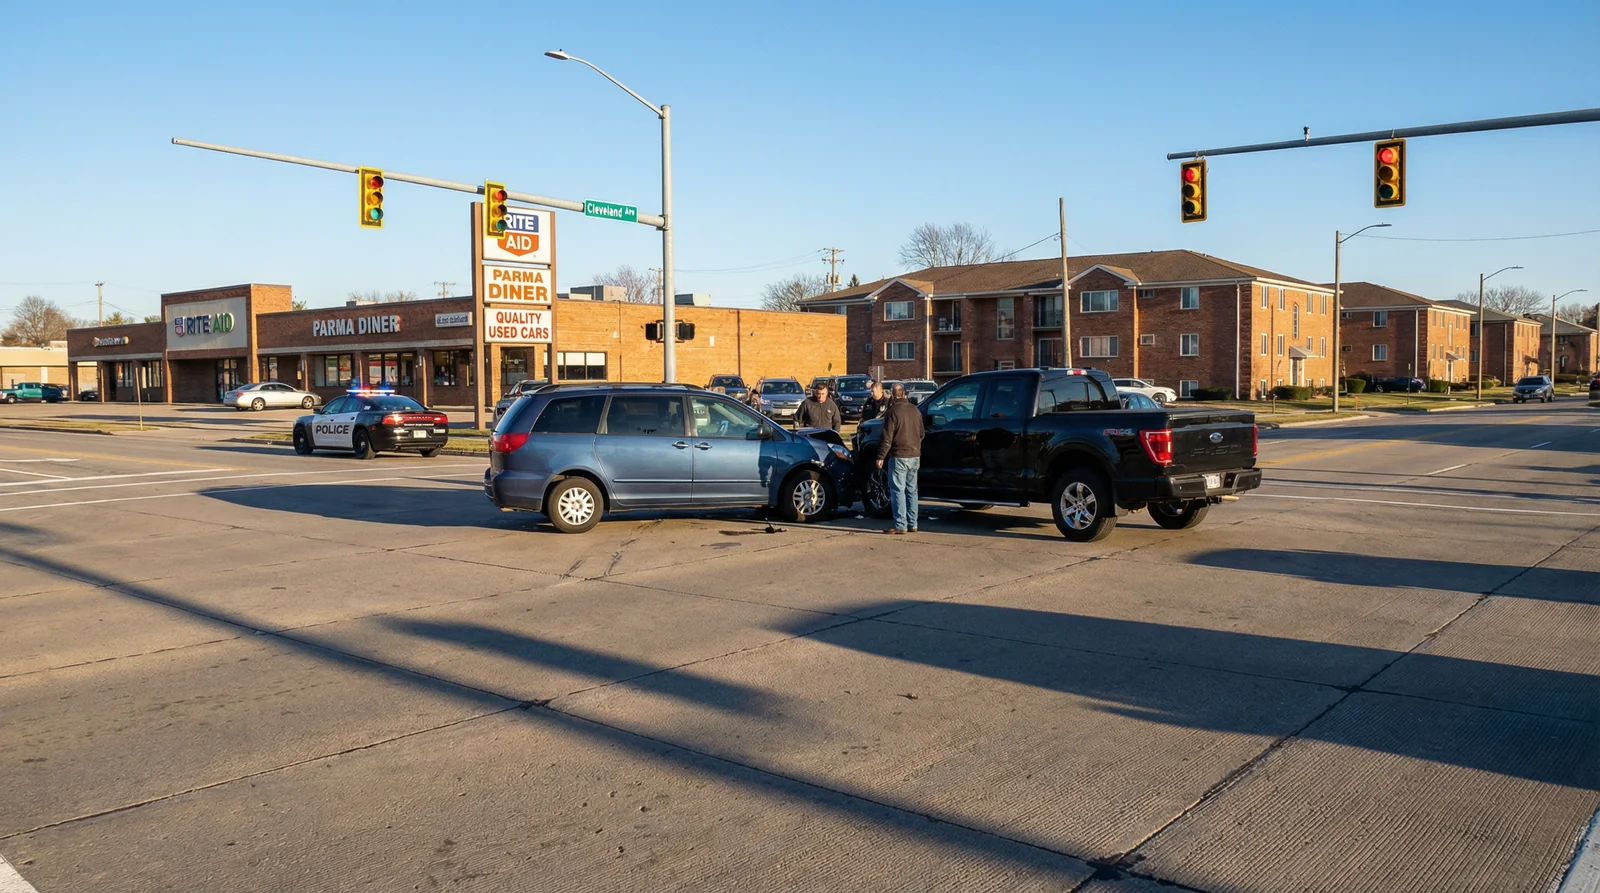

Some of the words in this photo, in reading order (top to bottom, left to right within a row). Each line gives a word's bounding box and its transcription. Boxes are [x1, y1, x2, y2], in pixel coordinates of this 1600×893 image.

[587, 203, 623, 218] Cleveland
[504, 213, 535, 231] RITE
[505, 234, 532, 251] AID
[493, 269, 543, 283] PARMA
[488, 283, 548, 301] DINER
[186, 314, 212, 336] RITE
[212, 312, 235, 334] AID
[312, 318, 355, 337] PARMA
[358, 314, 401, 335] DINER
[496, 311, 542, 325] QUALITY
[488, 325, 518, 340] USED
[522, 326, 549, 340] CARS
[315, 424, 350, 435] POLICE
